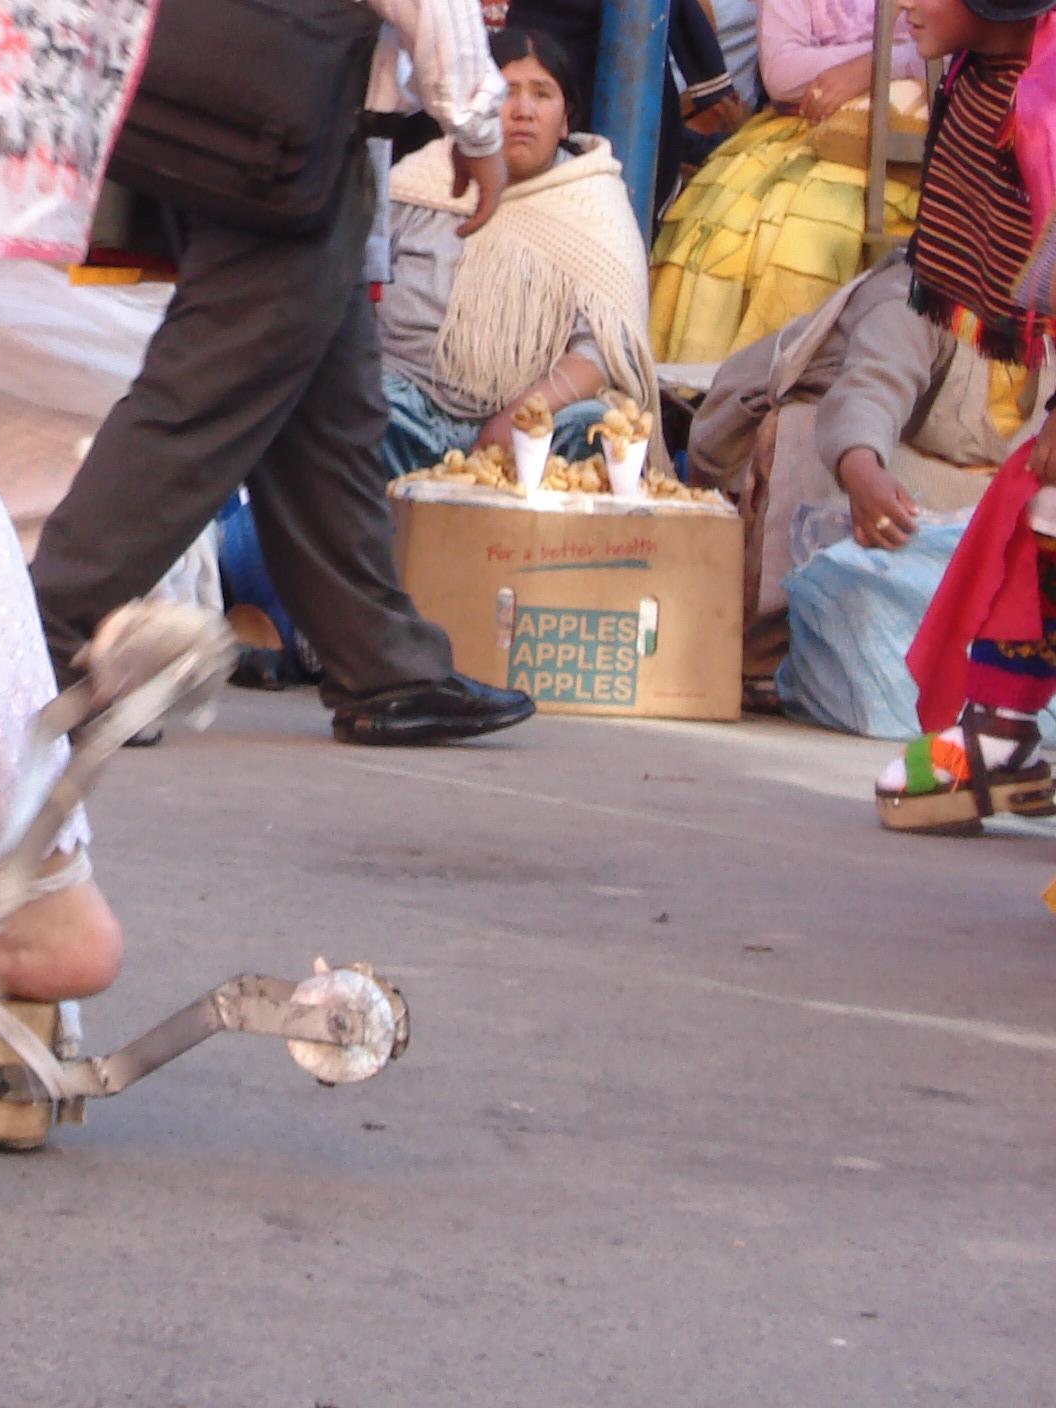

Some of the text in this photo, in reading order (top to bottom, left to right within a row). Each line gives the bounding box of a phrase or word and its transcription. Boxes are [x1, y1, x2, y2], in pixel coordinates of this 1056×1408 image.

[486, 544, 514, 561] For
[540, 539, 593, 561] better
[605, 537, 657, 557] health
[515, 612, 637, 645] APPLES
[512, 641, 635, 673] APPLES
[512, 670, 633, 702] APPLES
